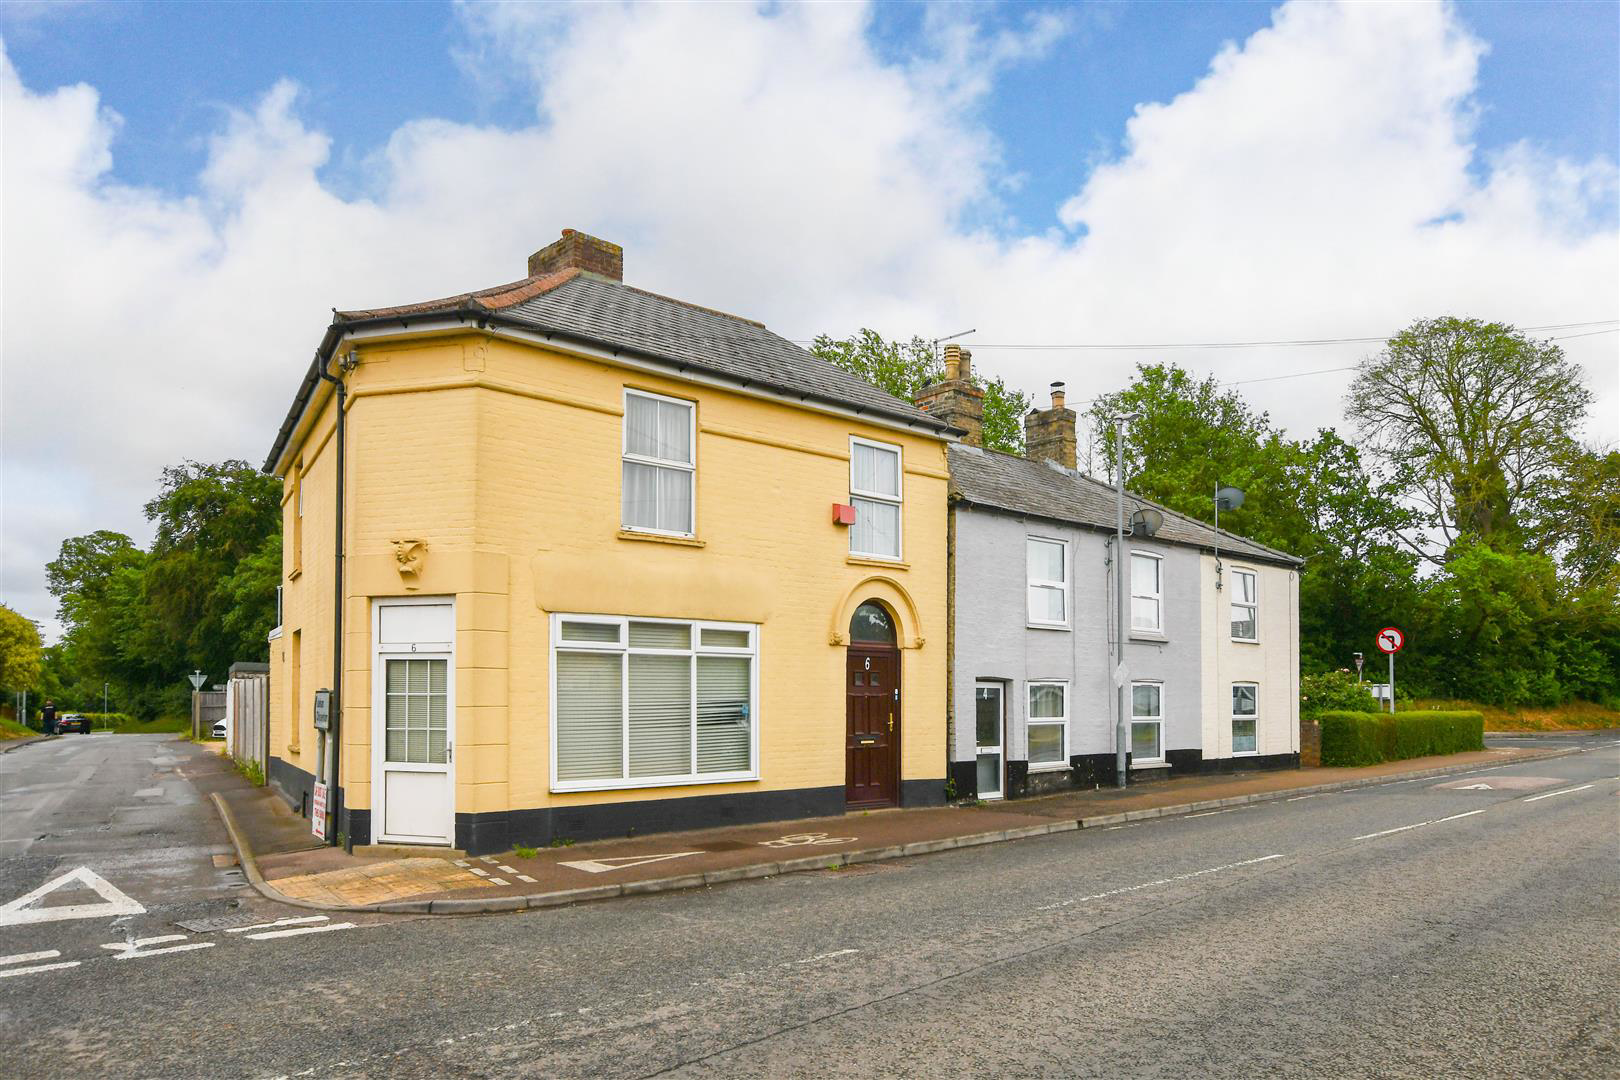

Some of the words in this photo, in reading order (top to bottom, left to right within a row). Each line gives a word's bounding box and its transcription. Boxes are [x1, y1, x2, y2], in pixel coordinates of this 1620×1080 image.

[411, 643, 417, 653] 6
[865, 656, 870, 670] 6
[982, 688, 988, 700] 4
